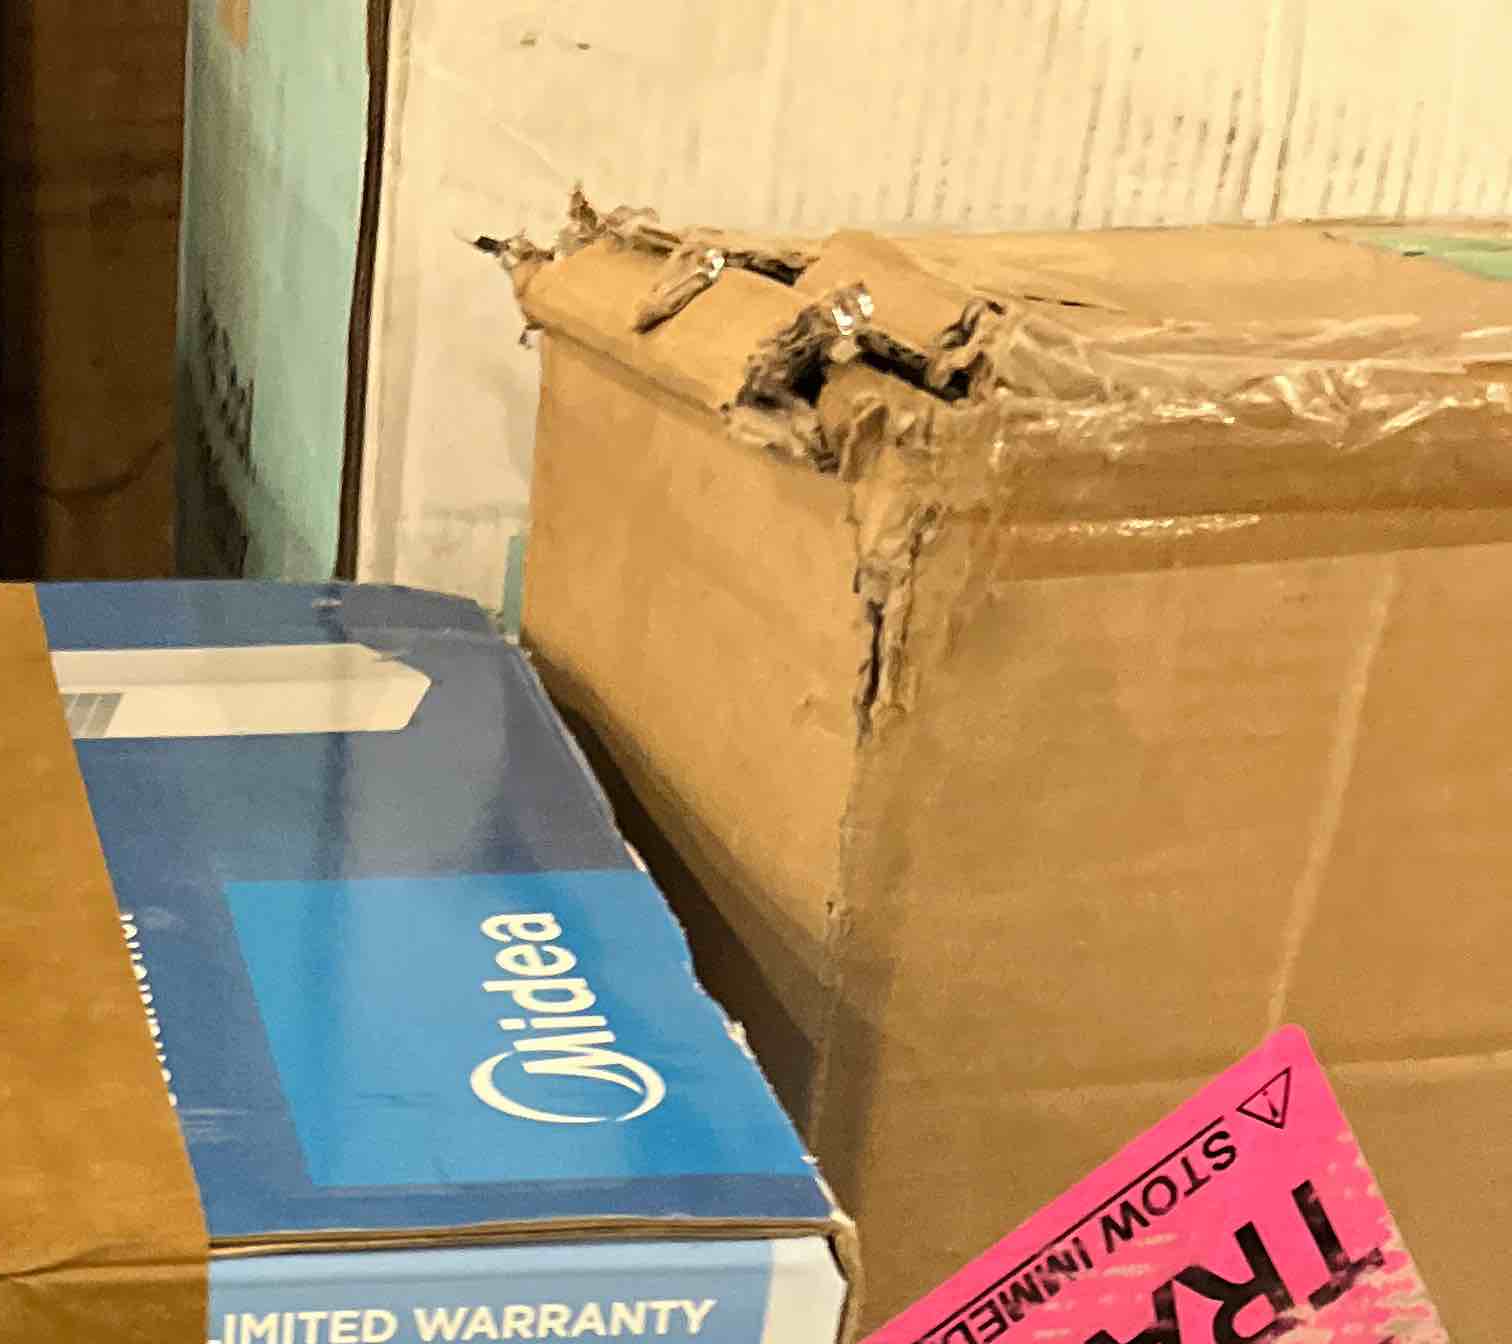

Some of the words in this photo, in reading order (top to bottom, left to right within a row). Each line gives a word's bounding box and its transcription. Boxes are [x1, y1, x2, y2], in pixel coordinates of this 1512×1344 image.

[469, 911, 666, 1124] Midea
[1099, 1129, 1239, 1256] STOW
[413, 1297, 718, 1343] WARRANTY
